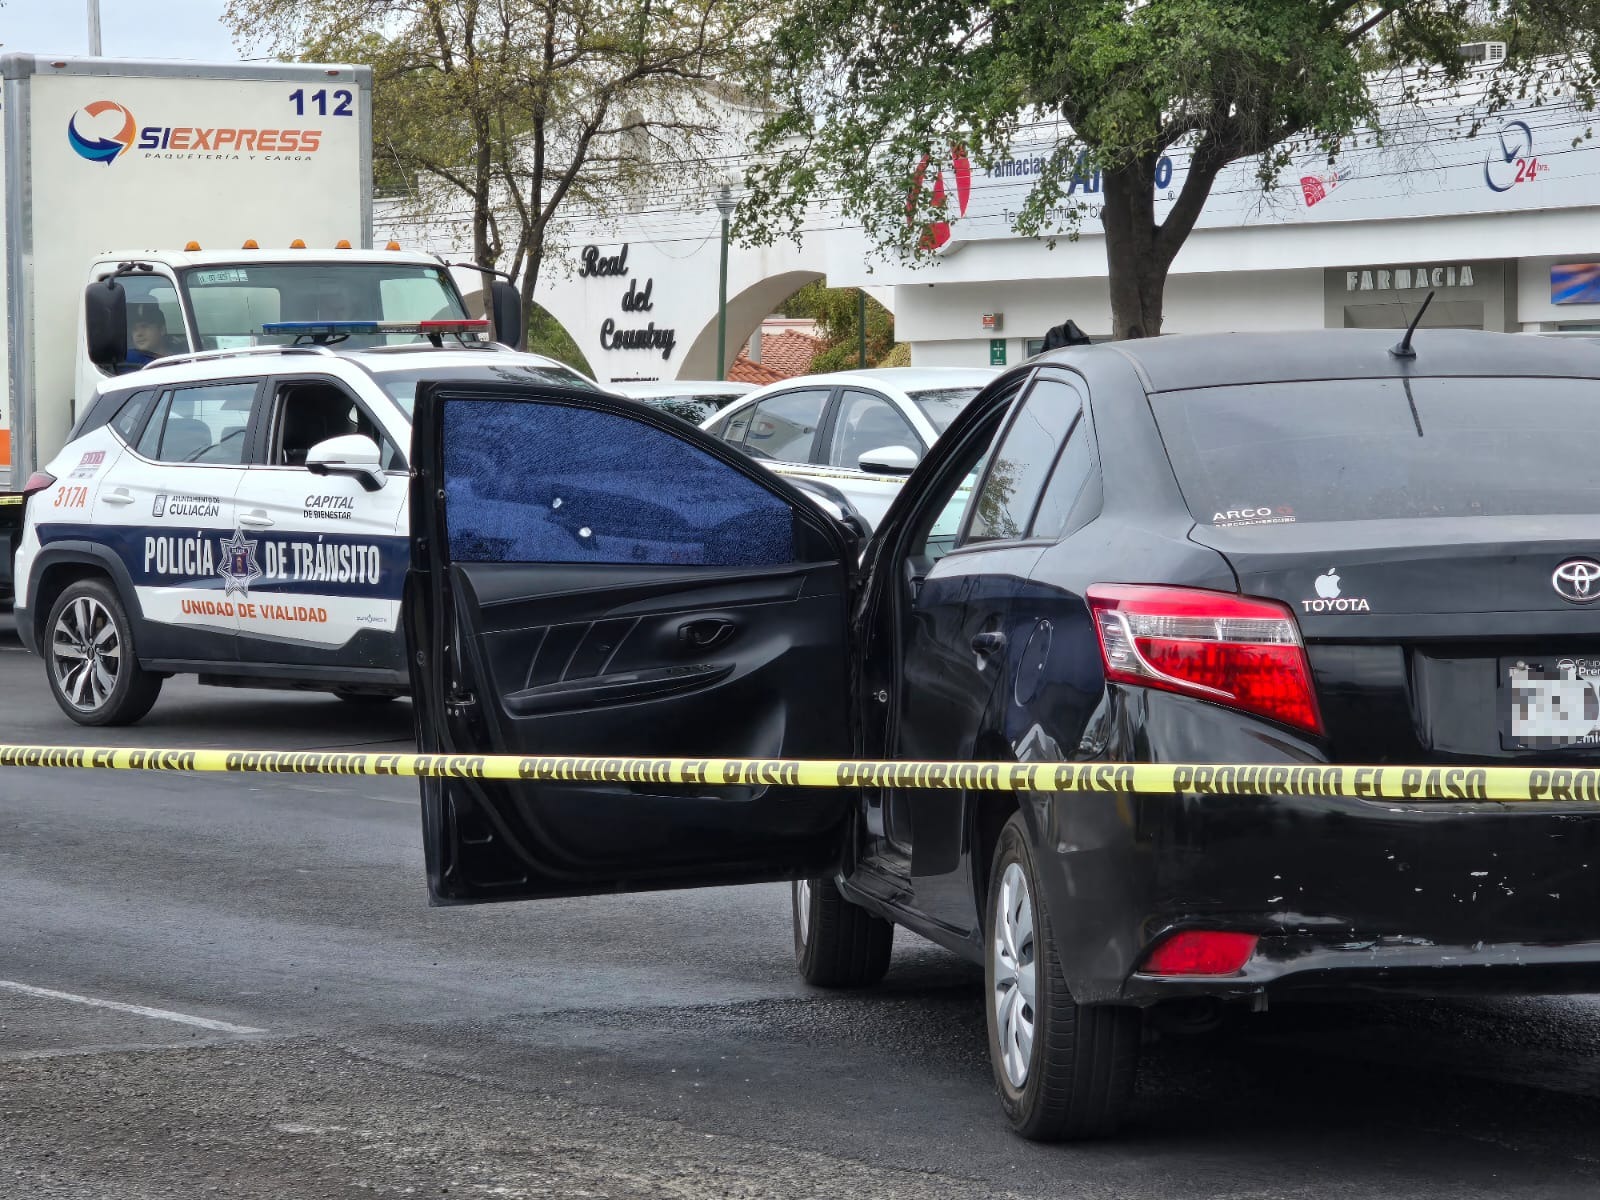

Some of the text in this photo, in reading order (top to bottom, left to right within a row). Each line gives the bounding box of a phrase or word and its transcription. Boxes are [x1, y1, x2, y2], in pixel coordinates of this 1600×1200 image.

[289, 88, 353, 117] 112
[138, 127, 323, 152] SIEXPRESS
[1515, 157, 1537, 183] 24
[579, 243, 629, 278] Real
[1346, 265, 1474, 291] FARMACIA
[621, 278, 654, 312] del
[600, 318, 676, 360] Country
[54, 486, 88, 508] 317A
[305, 494, 354, 509] CAPITAL
[169, 503, 220, 517] CULIACÁN
[303, 510, 352, 519] DE BIENESTAR
[1212, 507, 1272, 521] ARCO
[144, 533, 381, 585] POLICÍA DE TRÁNSITO
[181, 599, 328, 623] UNIDAD DE VIALIDAD
[1302, 599, 1370, 612] TOYOTA
[1529, 770, 1600, 801] PRO
